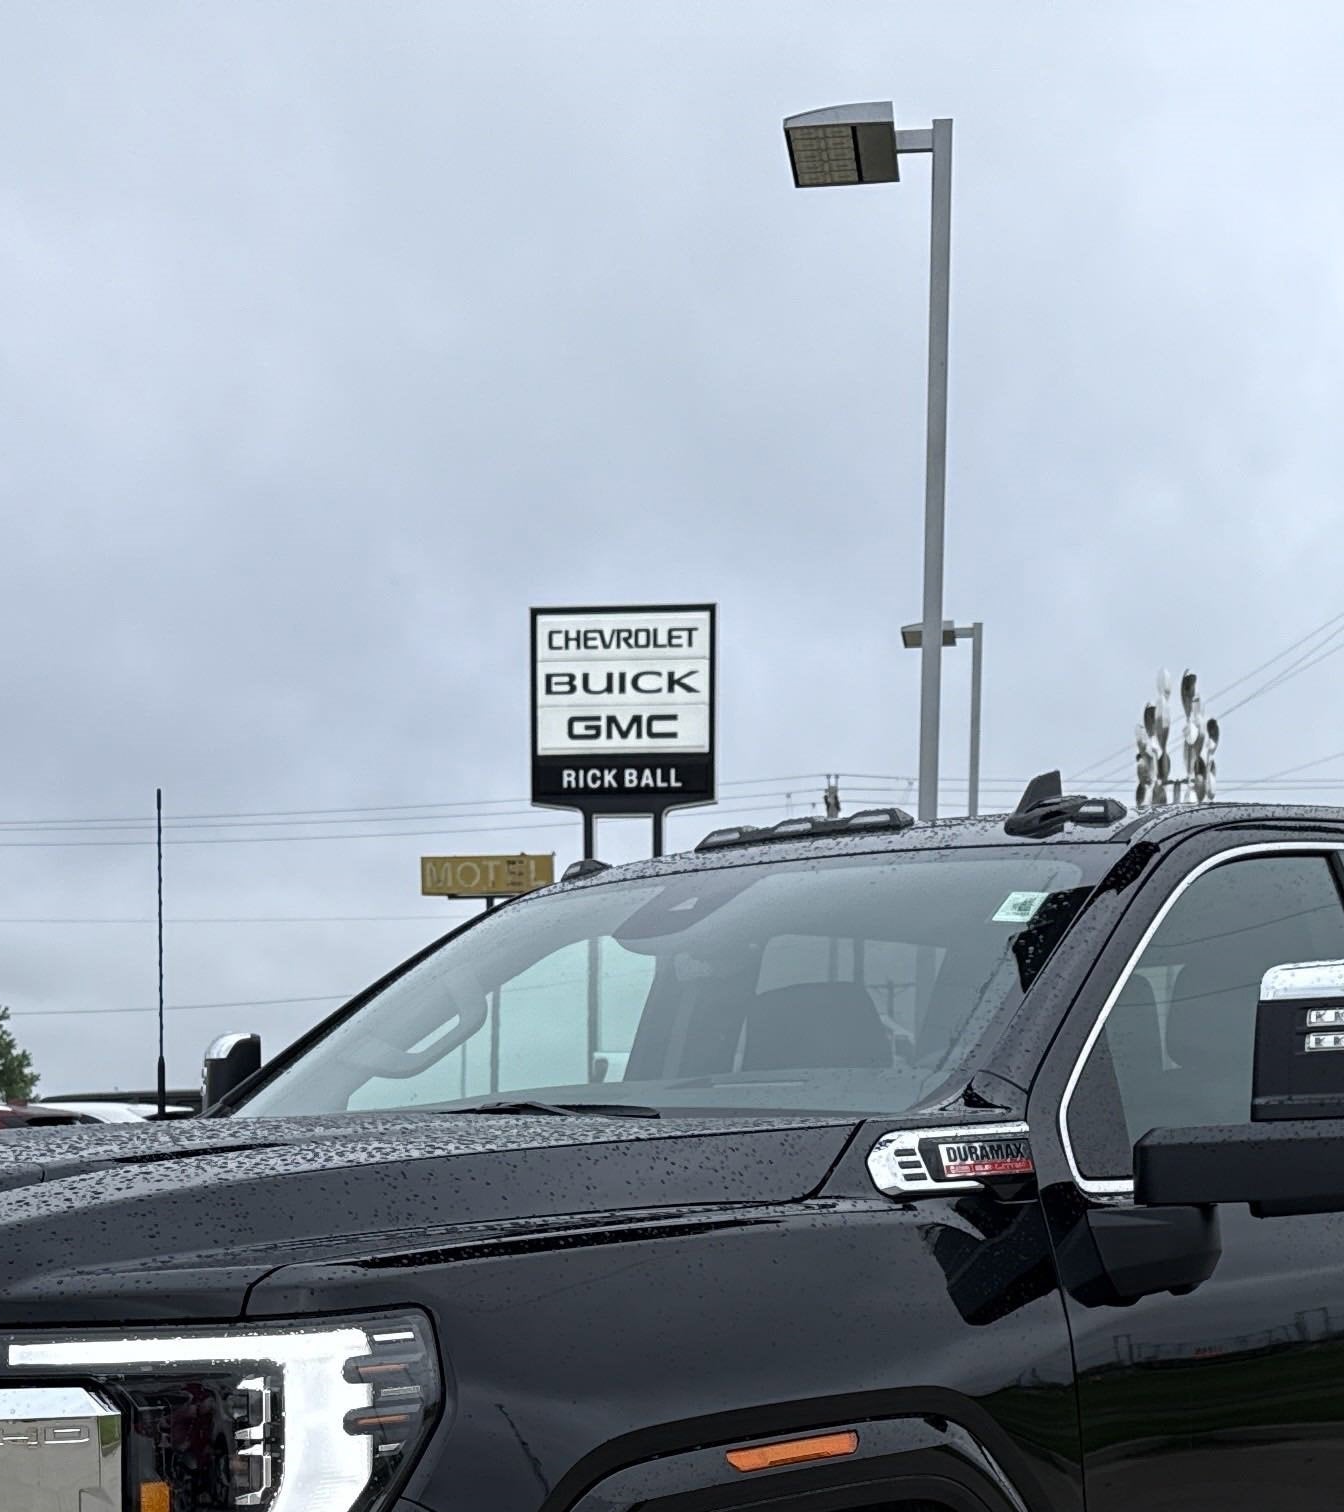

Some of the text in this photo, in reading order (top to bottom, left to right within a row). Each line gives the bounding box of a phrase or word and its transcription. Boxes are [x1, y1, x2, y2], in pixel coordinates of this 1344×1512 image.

[548, 627, 698, 650] CHEVROLET
[545, 670, 701, 695] BUICK
[567, 714, 679, 740] GMC
[562, 768, 682, 789] RICK BALL
[425, 859, 547, 889] MOTEL
[946, 1143, 1026, 1163] DURAMAX
